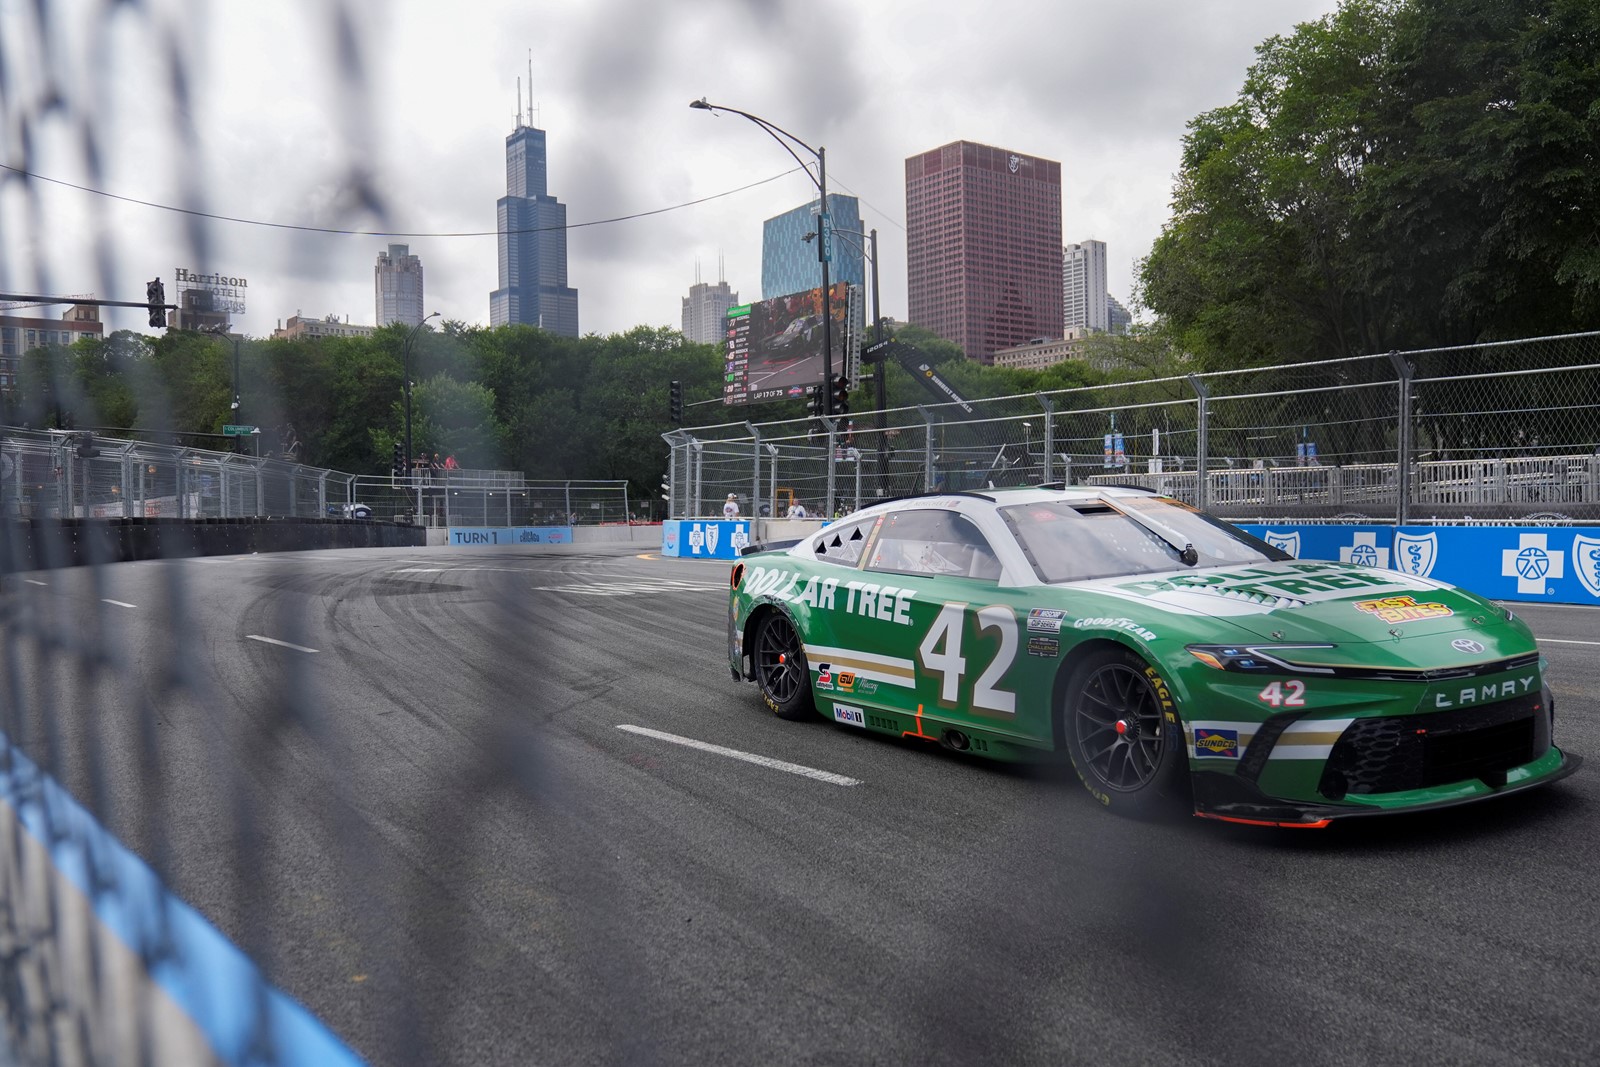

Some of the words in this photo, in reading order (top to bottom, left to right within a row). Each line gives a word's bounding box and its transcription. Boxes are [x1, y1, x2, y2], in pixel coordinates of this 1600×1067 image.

[175, 267, 248, 288] Harrison
[455, 532, 489, 544] TURN
[491, 531, 498, 545] 1
[743, 566, 841, 611] DOLLAR
[844, 580, 919, 625] TREE
[1358, 598, 1419, 612] FAST
[1381, 603, 1451, 622] BITES
[1073, 617, 1157, 642] GOODYEAR
[918, 601, 1019, 715] 42
[1144, 666, 1176, 725] EAGLE
[1258, 680, 1305, 708] 42
[835, 707, 855, 721] Mobil
[855, 711, 863, 723] 1
[1197, 739, 1236, 749] SUNOCO
